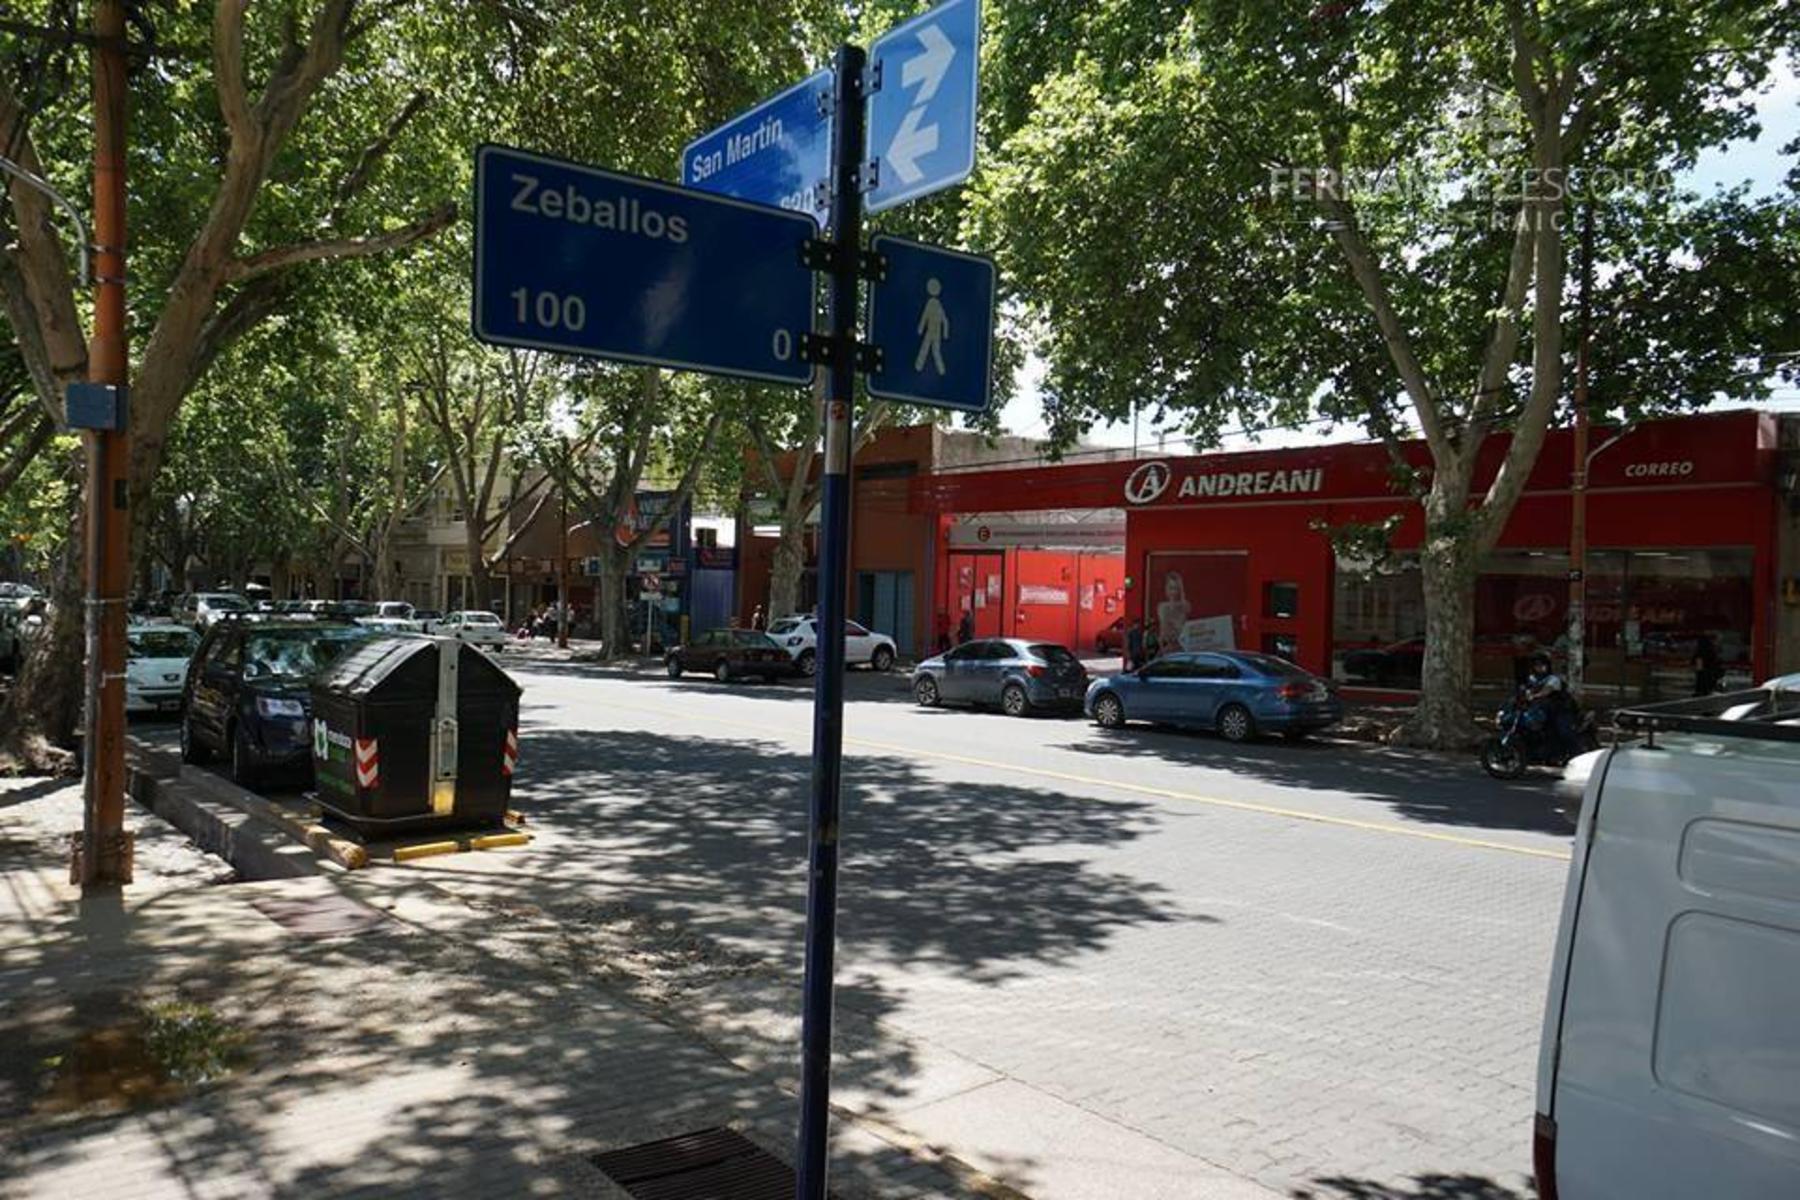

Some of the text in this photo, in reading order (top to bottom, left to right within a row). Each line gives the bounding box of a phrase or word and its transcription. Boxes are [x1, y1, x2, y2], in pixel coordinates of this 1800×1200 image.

[691, 150, 723, 183] San
[510, 173, 689, 244] Zeballos
[510, 286, 792, 361] 100 0
[1176, 468, 1324, 498] ANDREANI
[1624, 461, 1694, 478] CORREO
